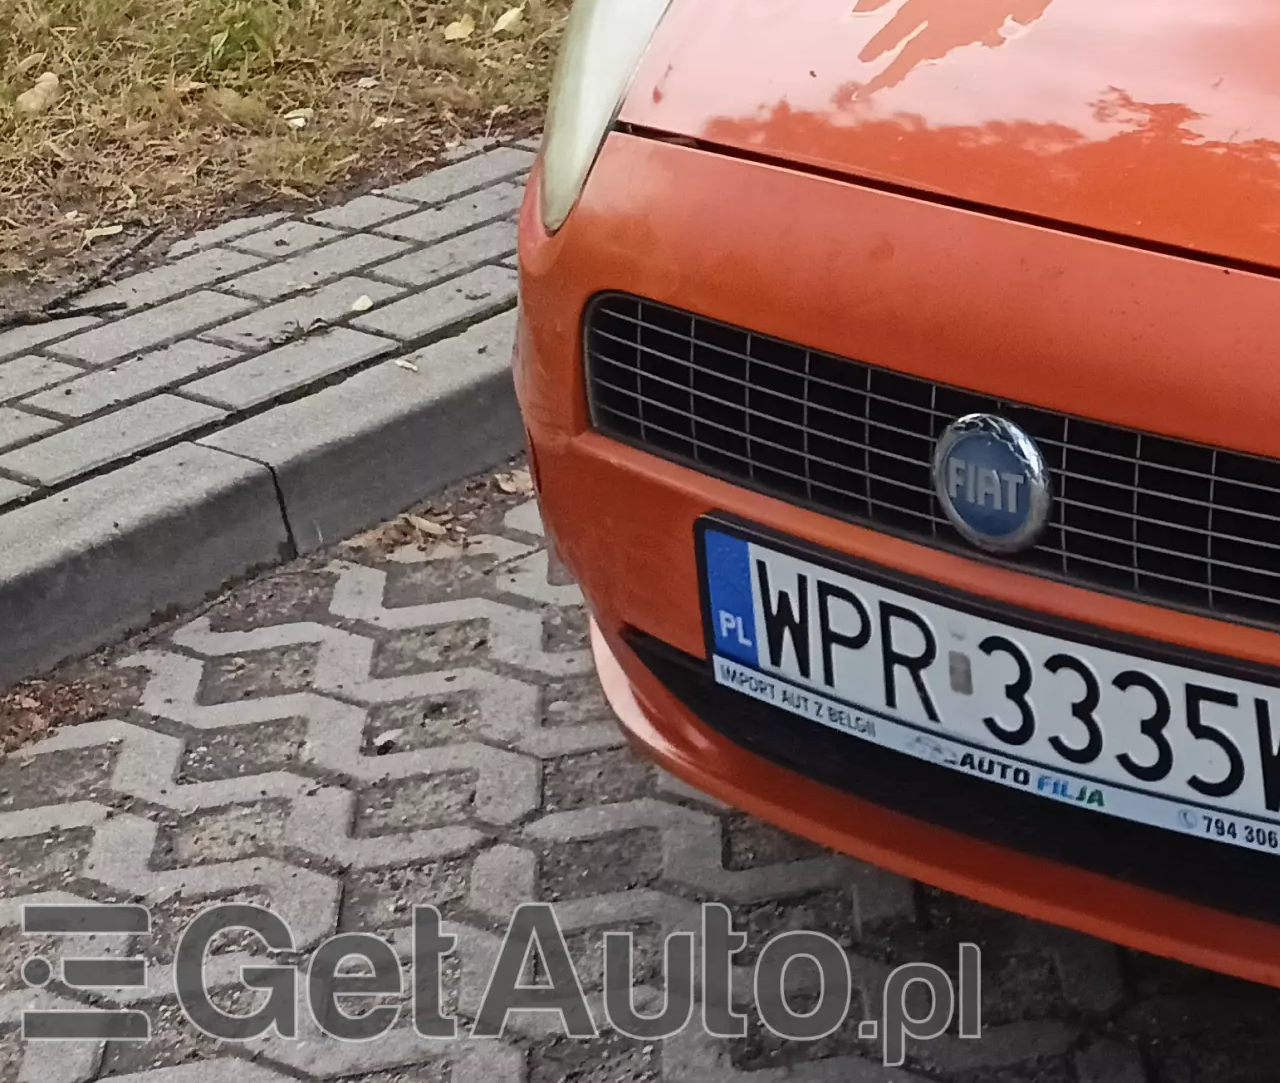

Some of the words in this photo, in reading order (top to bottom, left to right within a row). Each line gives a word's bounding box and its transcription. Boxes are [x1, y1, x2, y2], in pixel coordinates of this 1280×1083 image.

[949, 456, 1025, 514] FIAT
[719, 610, 752, 646] PL
[757, 559, 940, 723] WPR
[720, 664, 775, 699] IMPORT
[782, 690, 809, 712] AUT
[814, 701, 824, 717] Z
[959, 752, 1030, 786] AUTO
[1037, 774, 1105, 807] FILJA
[1203, 815, 1237, 839] 794
[1244, 825, 1278, 849] 306
